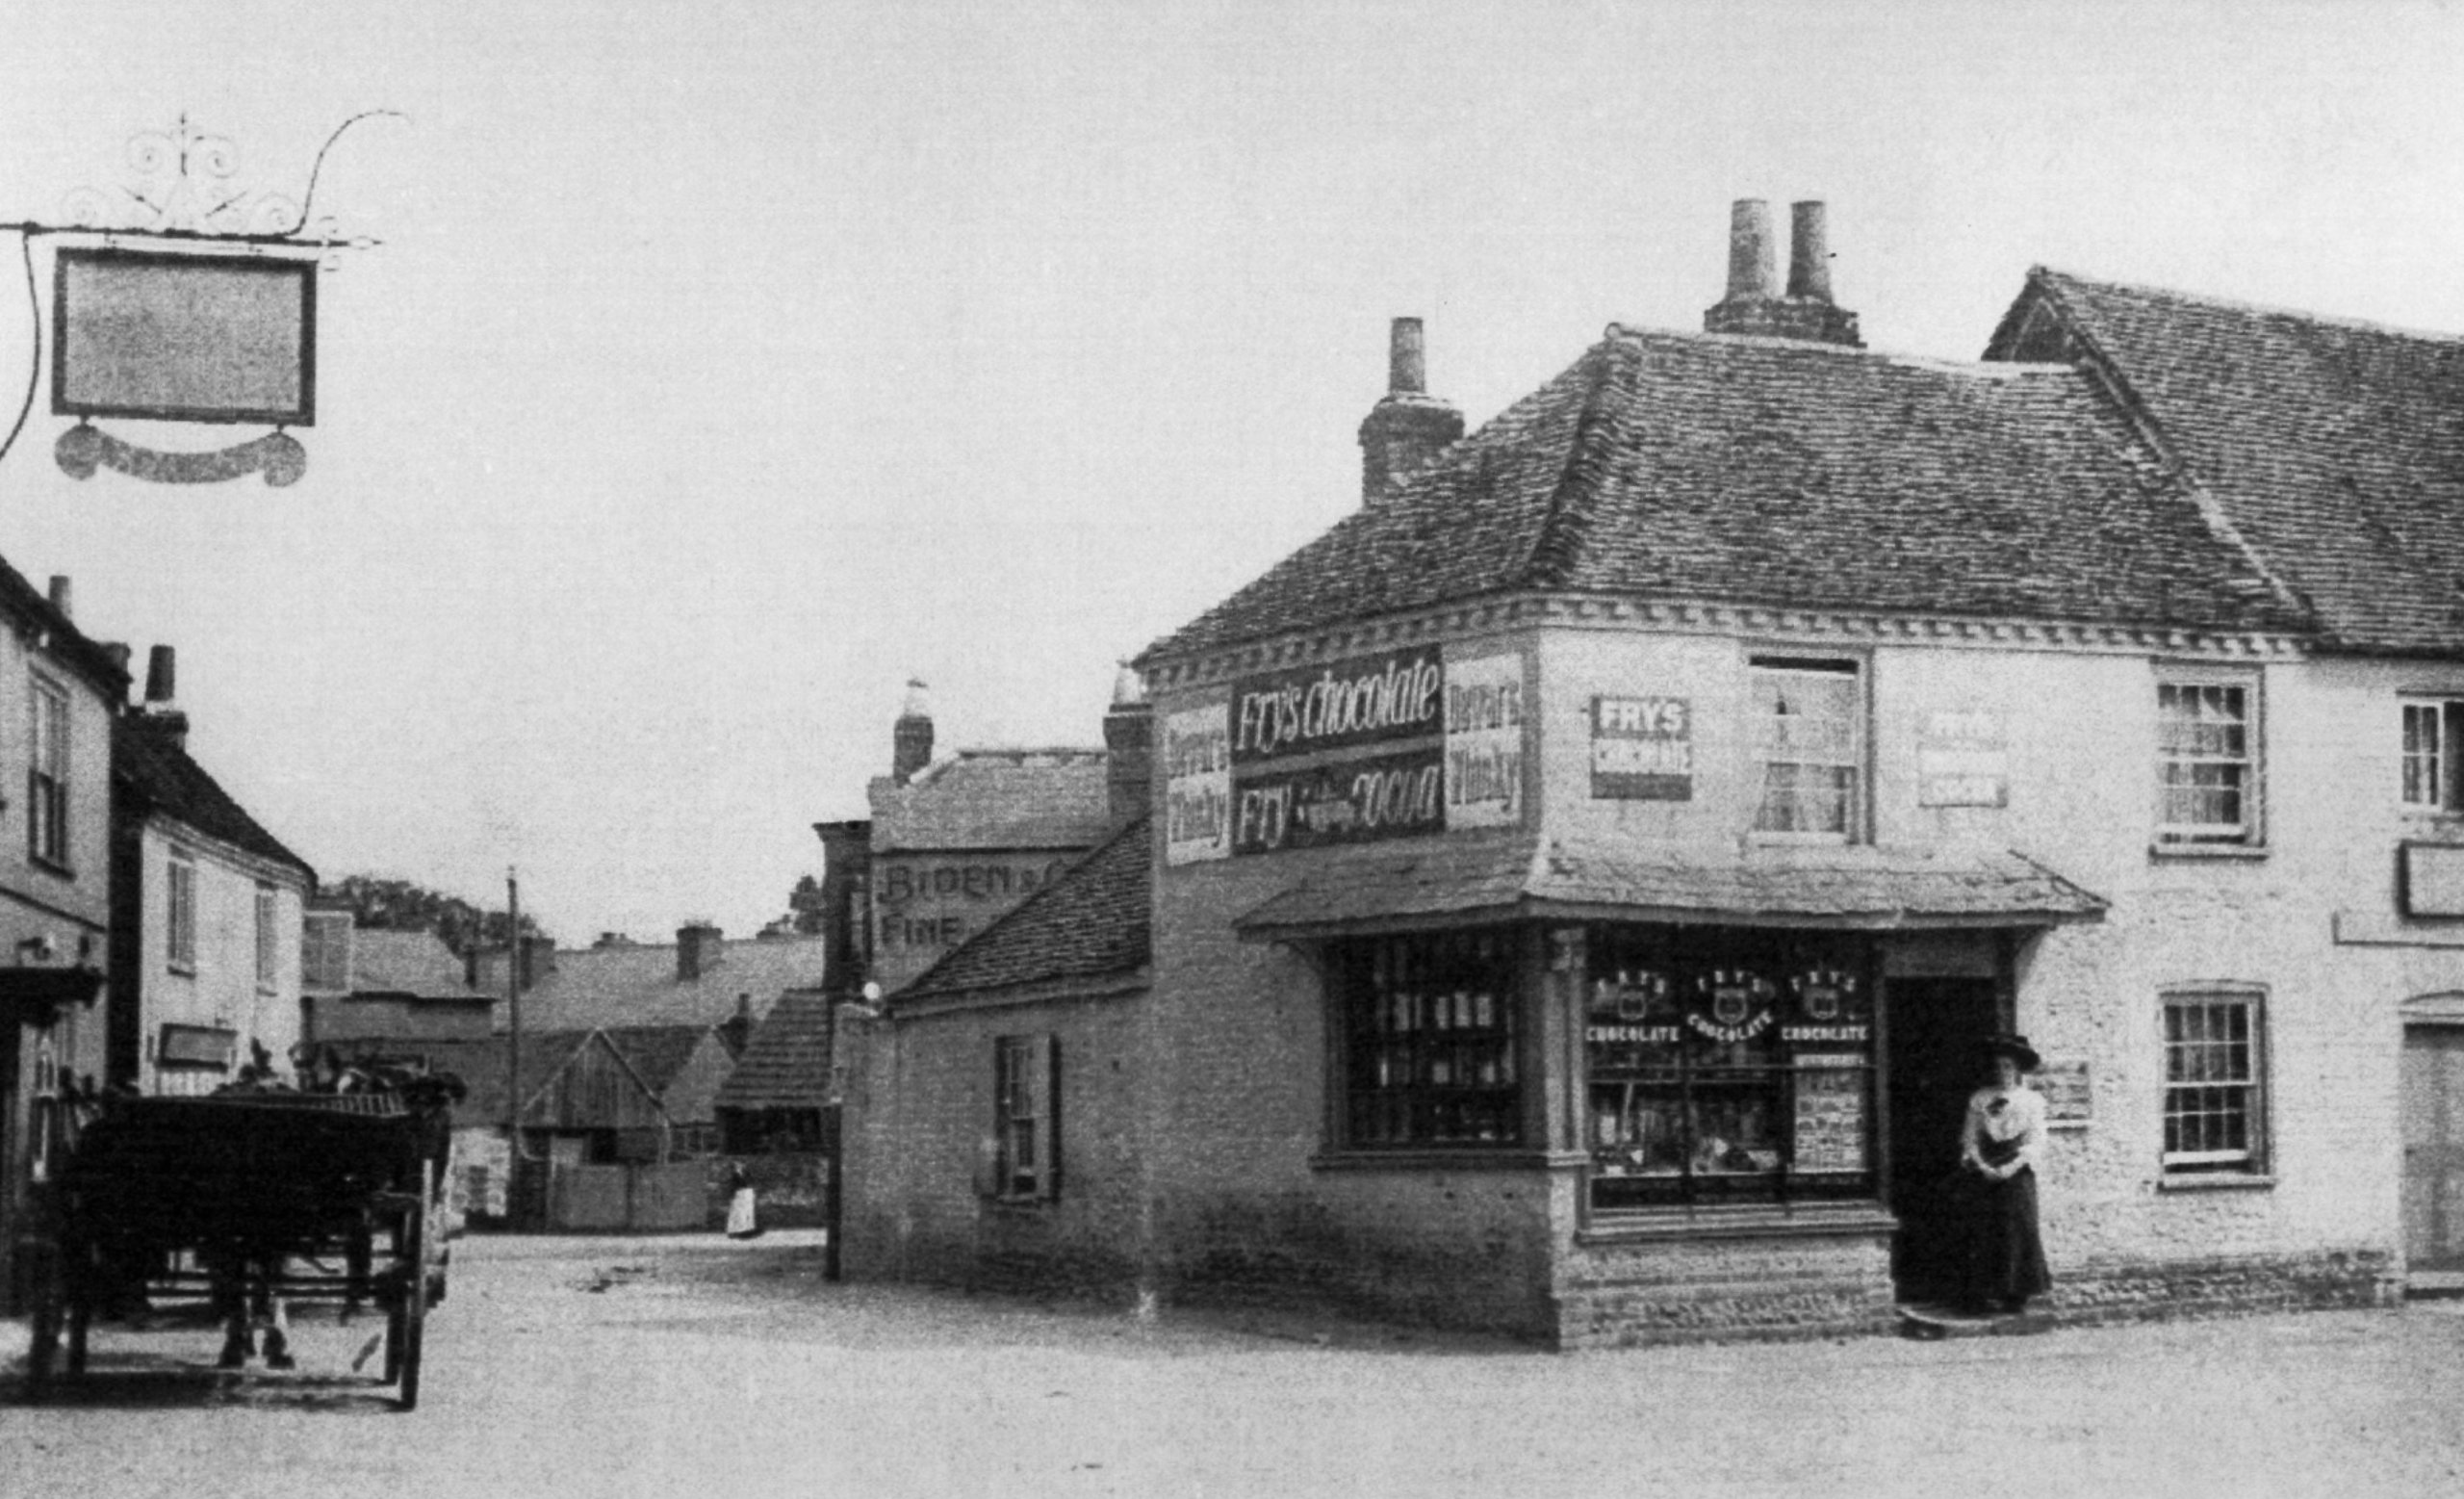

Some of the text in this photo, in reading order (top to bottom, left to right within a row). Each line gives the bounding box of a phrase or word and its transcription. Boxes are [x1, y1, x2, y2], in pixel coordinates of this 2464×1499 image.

[1235, 685, 1301, 753] Fry's
[1585, 1026, 1680, 1042] CHOCOLATE
[1687, 1011, 1773, 1042] CHOCOLATE
[1781, 1026, 1867, 1041] CHOCOLATE
